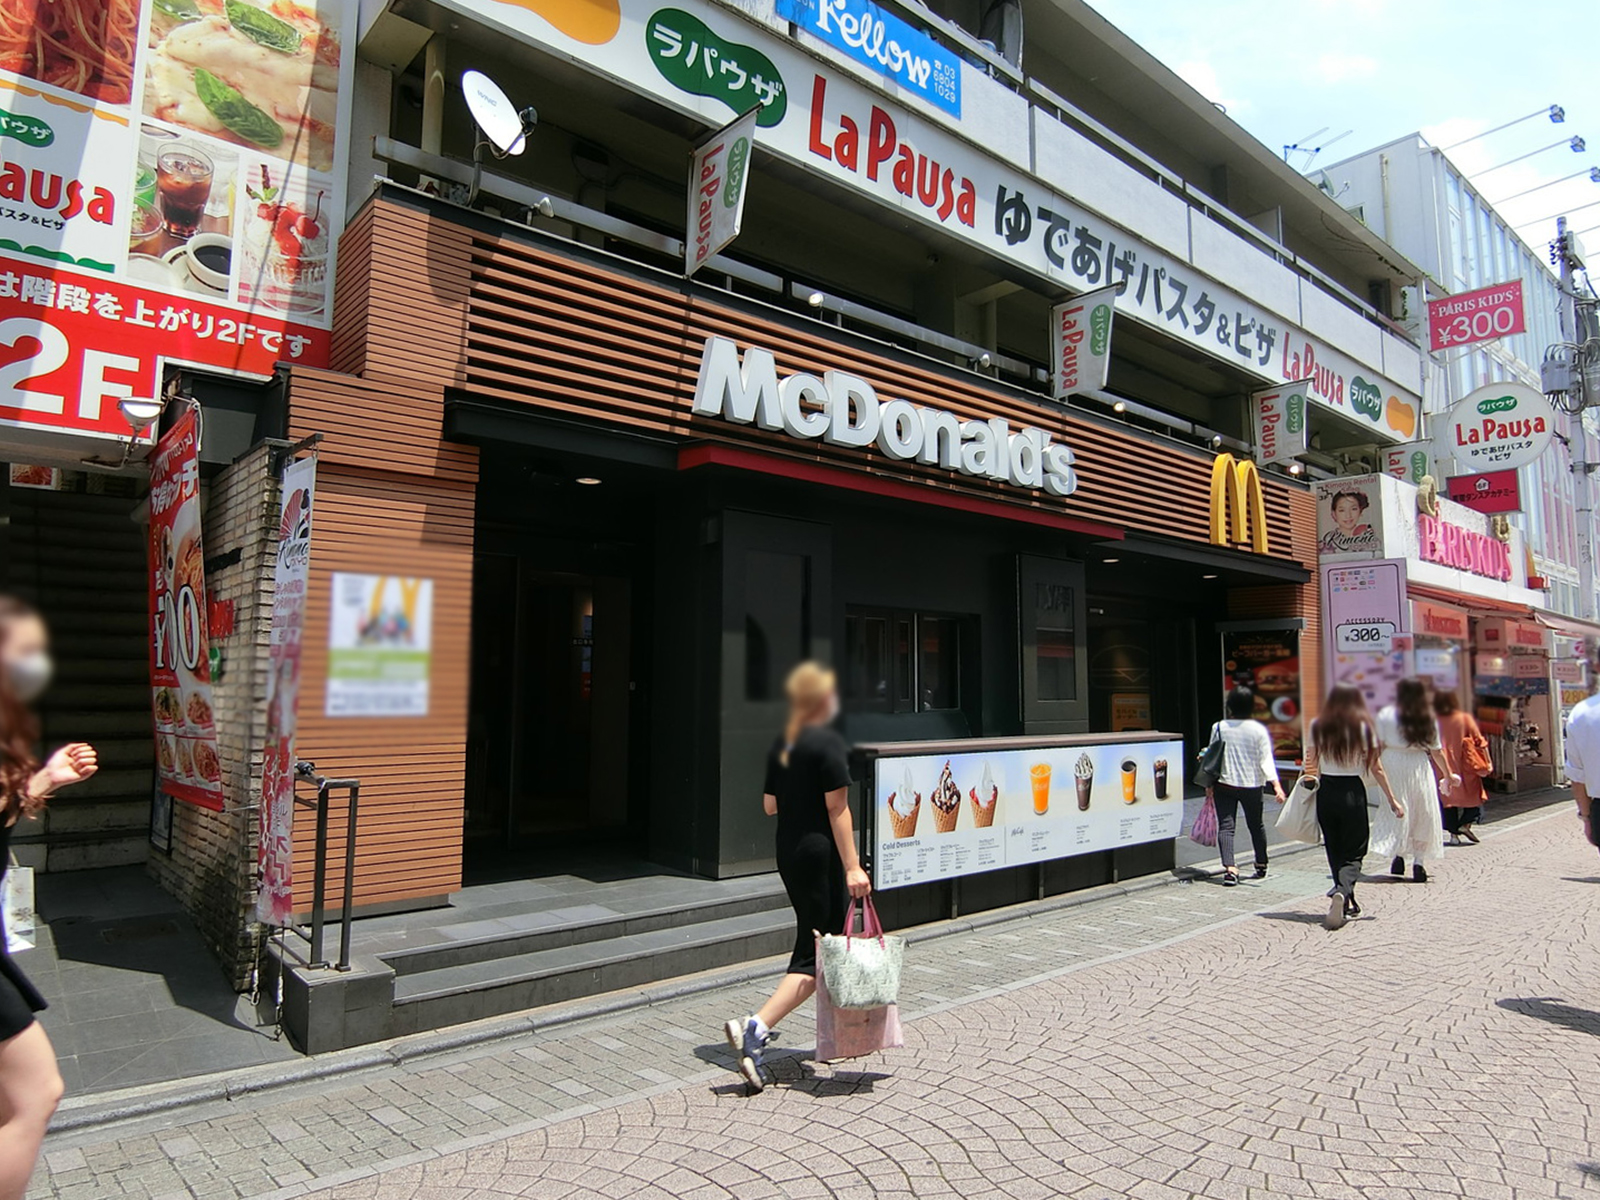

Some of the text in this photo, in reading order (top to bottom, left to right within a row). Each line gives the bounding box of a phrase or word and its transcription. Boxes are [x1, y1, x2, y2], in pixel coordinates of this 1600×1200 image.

[653, 23, 783, 107] ラパウザ
[933, 70, 955, 91] 6804
[934, 83, 956, 103] 1029
[1438, 290, 1514, 318] PARIS KID'S
[1438, 306, 1514, 345] ¥300
[692, 335, 1078, 497] McDonald's
[1324, 475, 1377, 489] Kimono Rental
[882, 840, 921, 850] Cold Desserts
